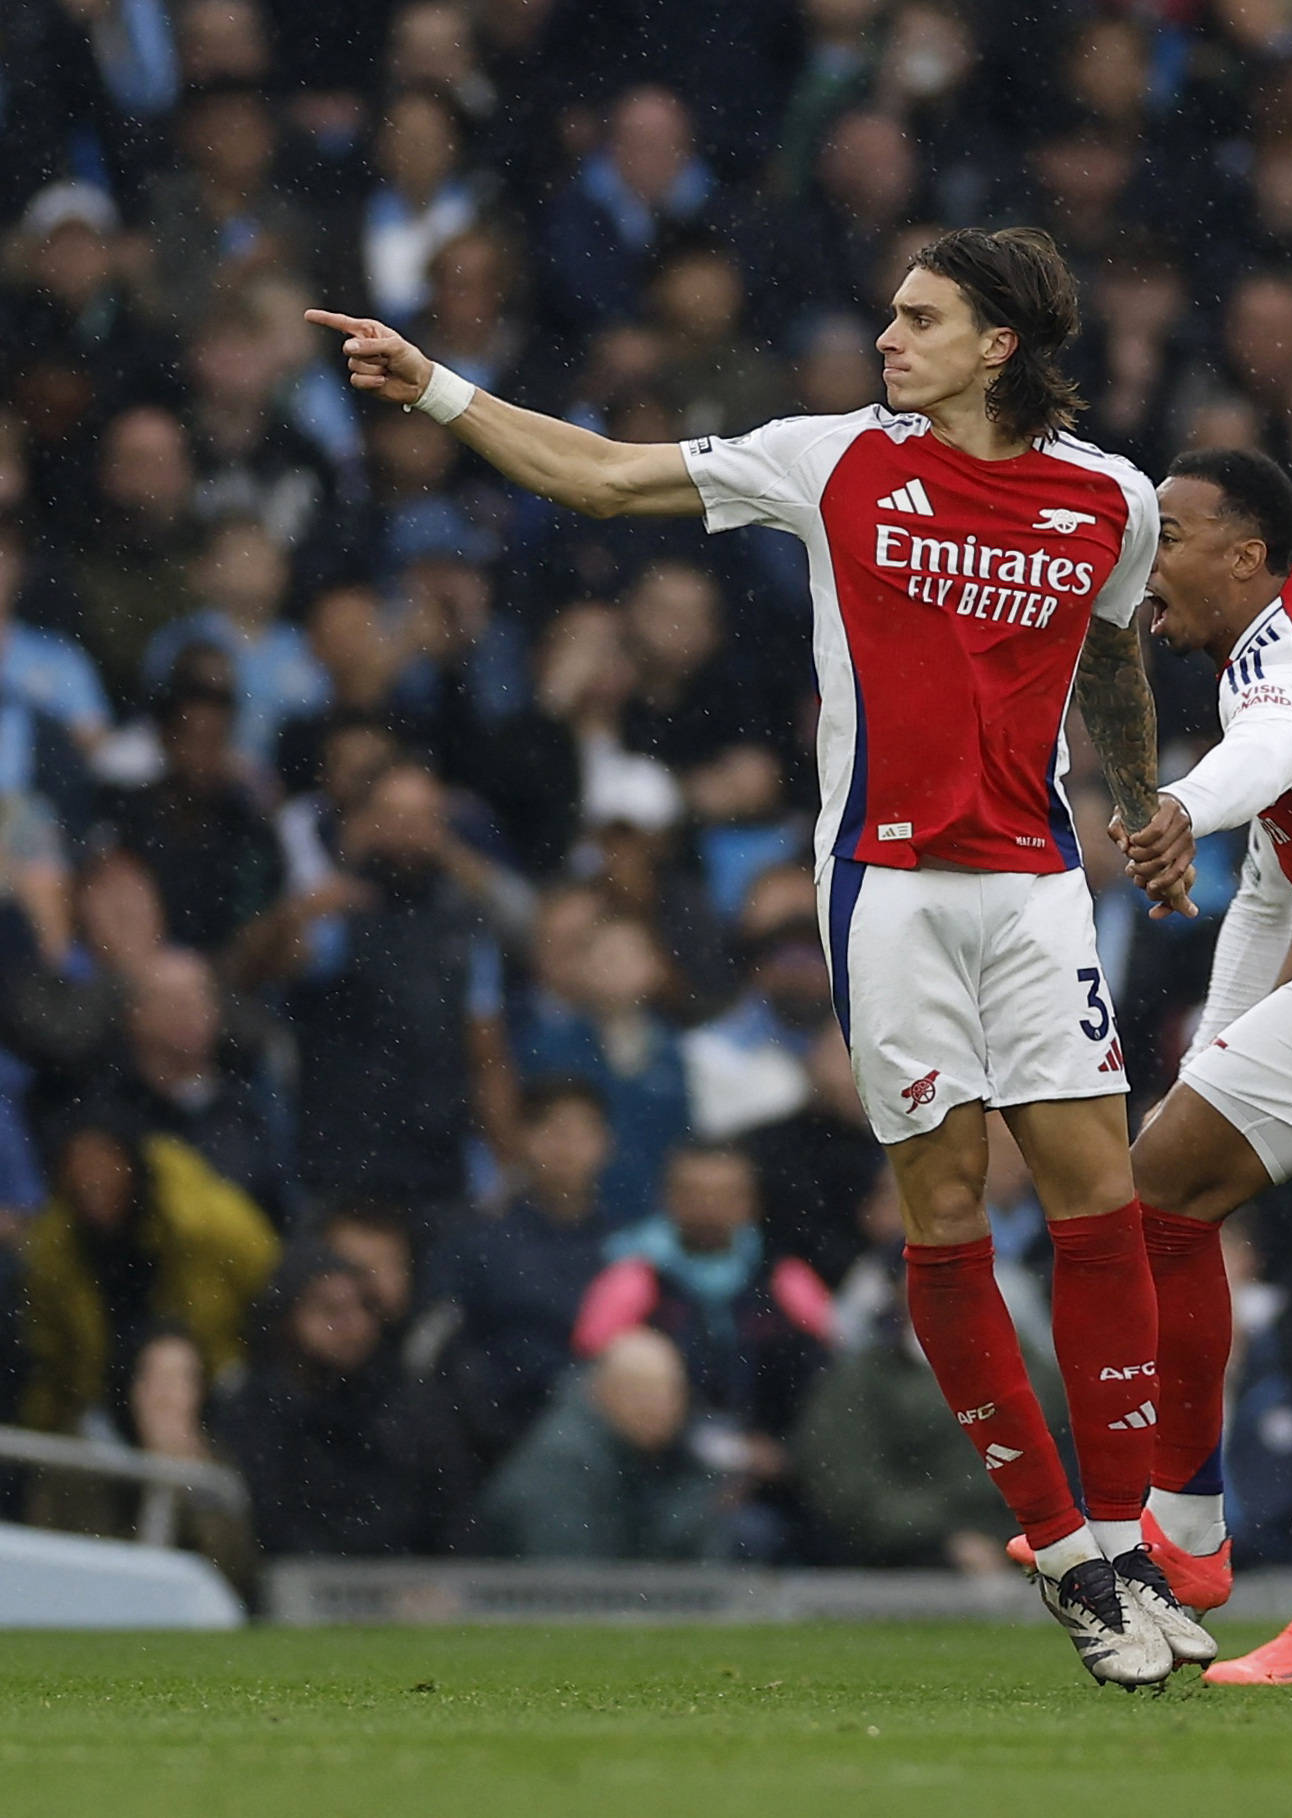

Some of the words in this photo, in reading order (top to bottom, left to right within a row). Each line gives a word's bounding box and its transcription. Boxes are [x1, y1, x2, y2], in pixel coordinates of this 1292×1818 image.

[875, 523, 1094, 595] Emirates
[908, 575, 953, 607] FLY
[956, 582, 1058, 629] BETTER
[1241, 684, 1287, 699] VISIT
[1077, 967, 1118, 1041] 3
[1100, 1361, 1156, 1381] AFC
[957, 1402, 995, 1425] AFC
